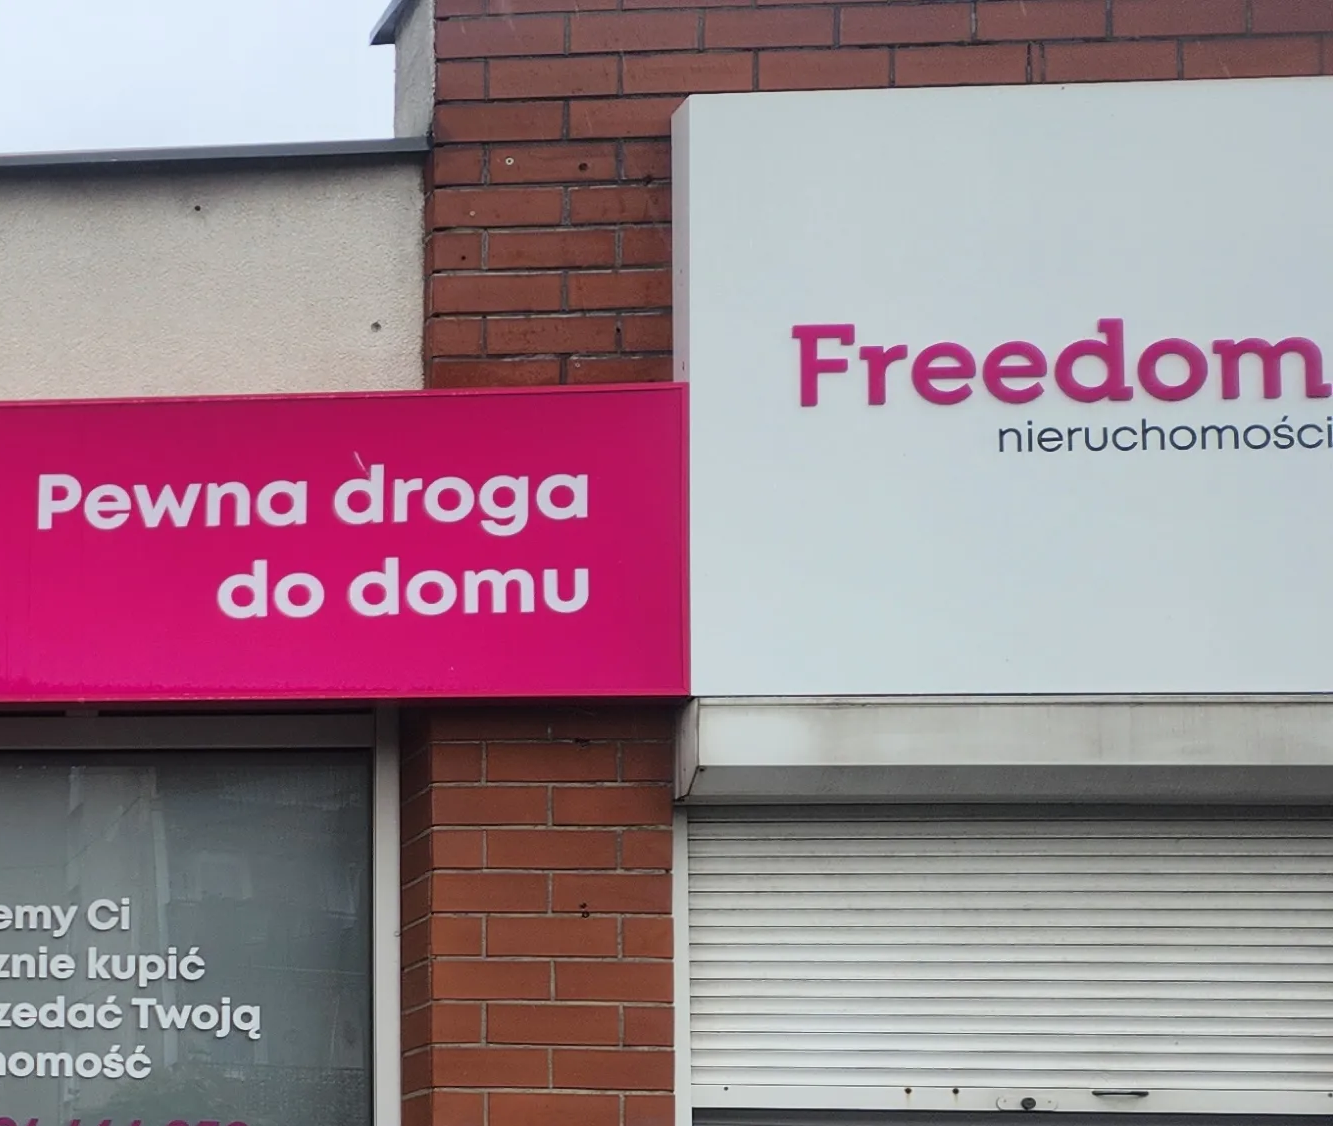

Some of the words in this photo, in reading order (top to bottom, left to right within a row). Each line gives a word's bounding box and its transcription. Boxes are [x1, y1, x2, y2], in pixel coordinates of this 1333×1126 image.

[791, 317, 1332, 408] Freedom
[998, 415, 1333, 453] nieruchomości
[36, 472, 308, 532] Pewna
[333, 463, 591, 537] droga
[216, 559, 325, 620] do
[346, 556, 590, 618] domu
[86, 896, 132, 932] Ci
[86, 945, 206, 988] kupić
[132, 997, 262, 1040] Twoją
